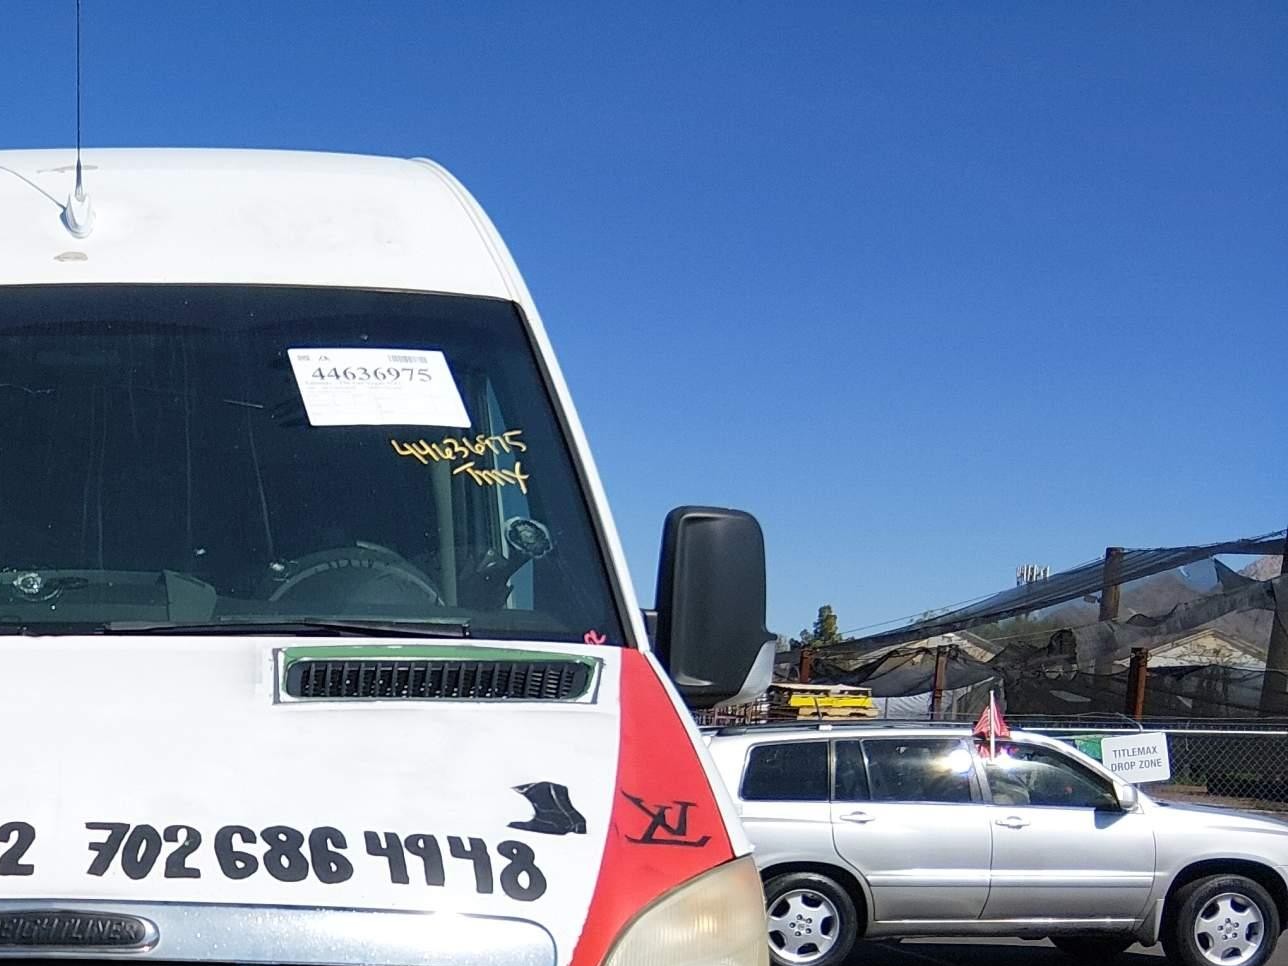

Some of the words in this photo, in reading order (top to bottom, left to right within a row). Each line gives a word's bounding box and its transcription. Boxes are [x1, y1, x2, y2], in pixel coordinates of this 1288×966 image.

[311, 366, 433, 383] 44636975
[1112, 745, 1158, 759] TITLEMAX
[1111, 761, 1136, 772] DROP
[1138, 758, 1162, 769] ZONE
[85, 822, 202, 880] 702
[214, 824, 354, 884] 686
[364, 830, 547, 902] 4948
